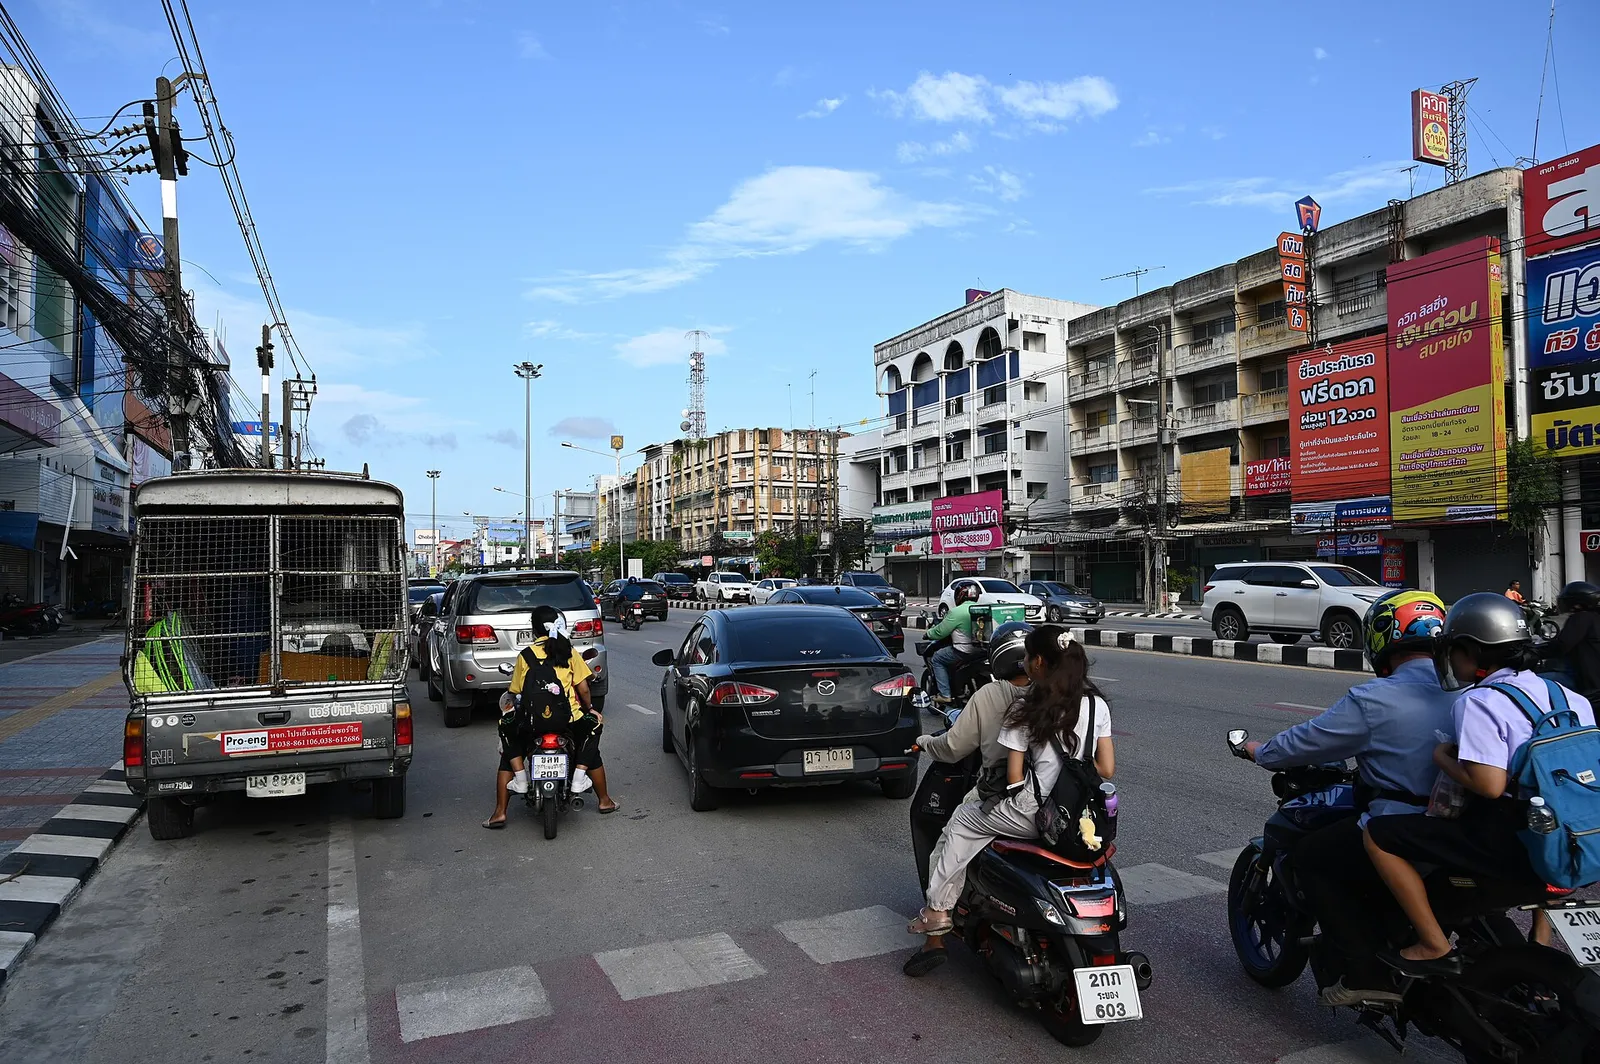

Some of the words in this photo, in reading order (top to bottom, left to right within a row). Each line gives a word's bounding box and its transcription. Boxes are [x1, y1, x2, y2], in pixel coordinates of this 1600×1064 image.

[1422, 96, 1447, 113] ควิก
[1425, 129, 1446, 147] จำนำ
[1557, 157, 1580, 170] ระยอง
[1282, 236, 1303, 254] เงิน
[1284, 262, 1302, 278] สด
[1287, 285, 1304, 304] ทัน
[1291, 308, 1303, 328] ใจ
[1397, 310, 1417, 328] ควิก
[1419, 327, 1473, 359] สบายใจ
[1544, 327, 1580, 354] ทีวี
[1299, 353, 1374, 379] ซื้อประกันรถ
[1300, 376, 1376, 407] ฟรีดอก
[1301, 411, 1327, 425] ผ่อน
[1328, 408, 1348, 426] 12
[1348, 407, 1376, 422] งวด
[935, 506, 998, 529] กายภาพบำบัด
[1348, 531, 1378, 547] 0.66
[309, 703, 331, 719] แอร์
[331, 701, 388, 717] บ้าน-โรงงาน
[226, 736, 267, 747] Pro-eng
[1097, 991, 1119, 1001] ระยอง
[1095, 1002, 1127, 1018] 603
